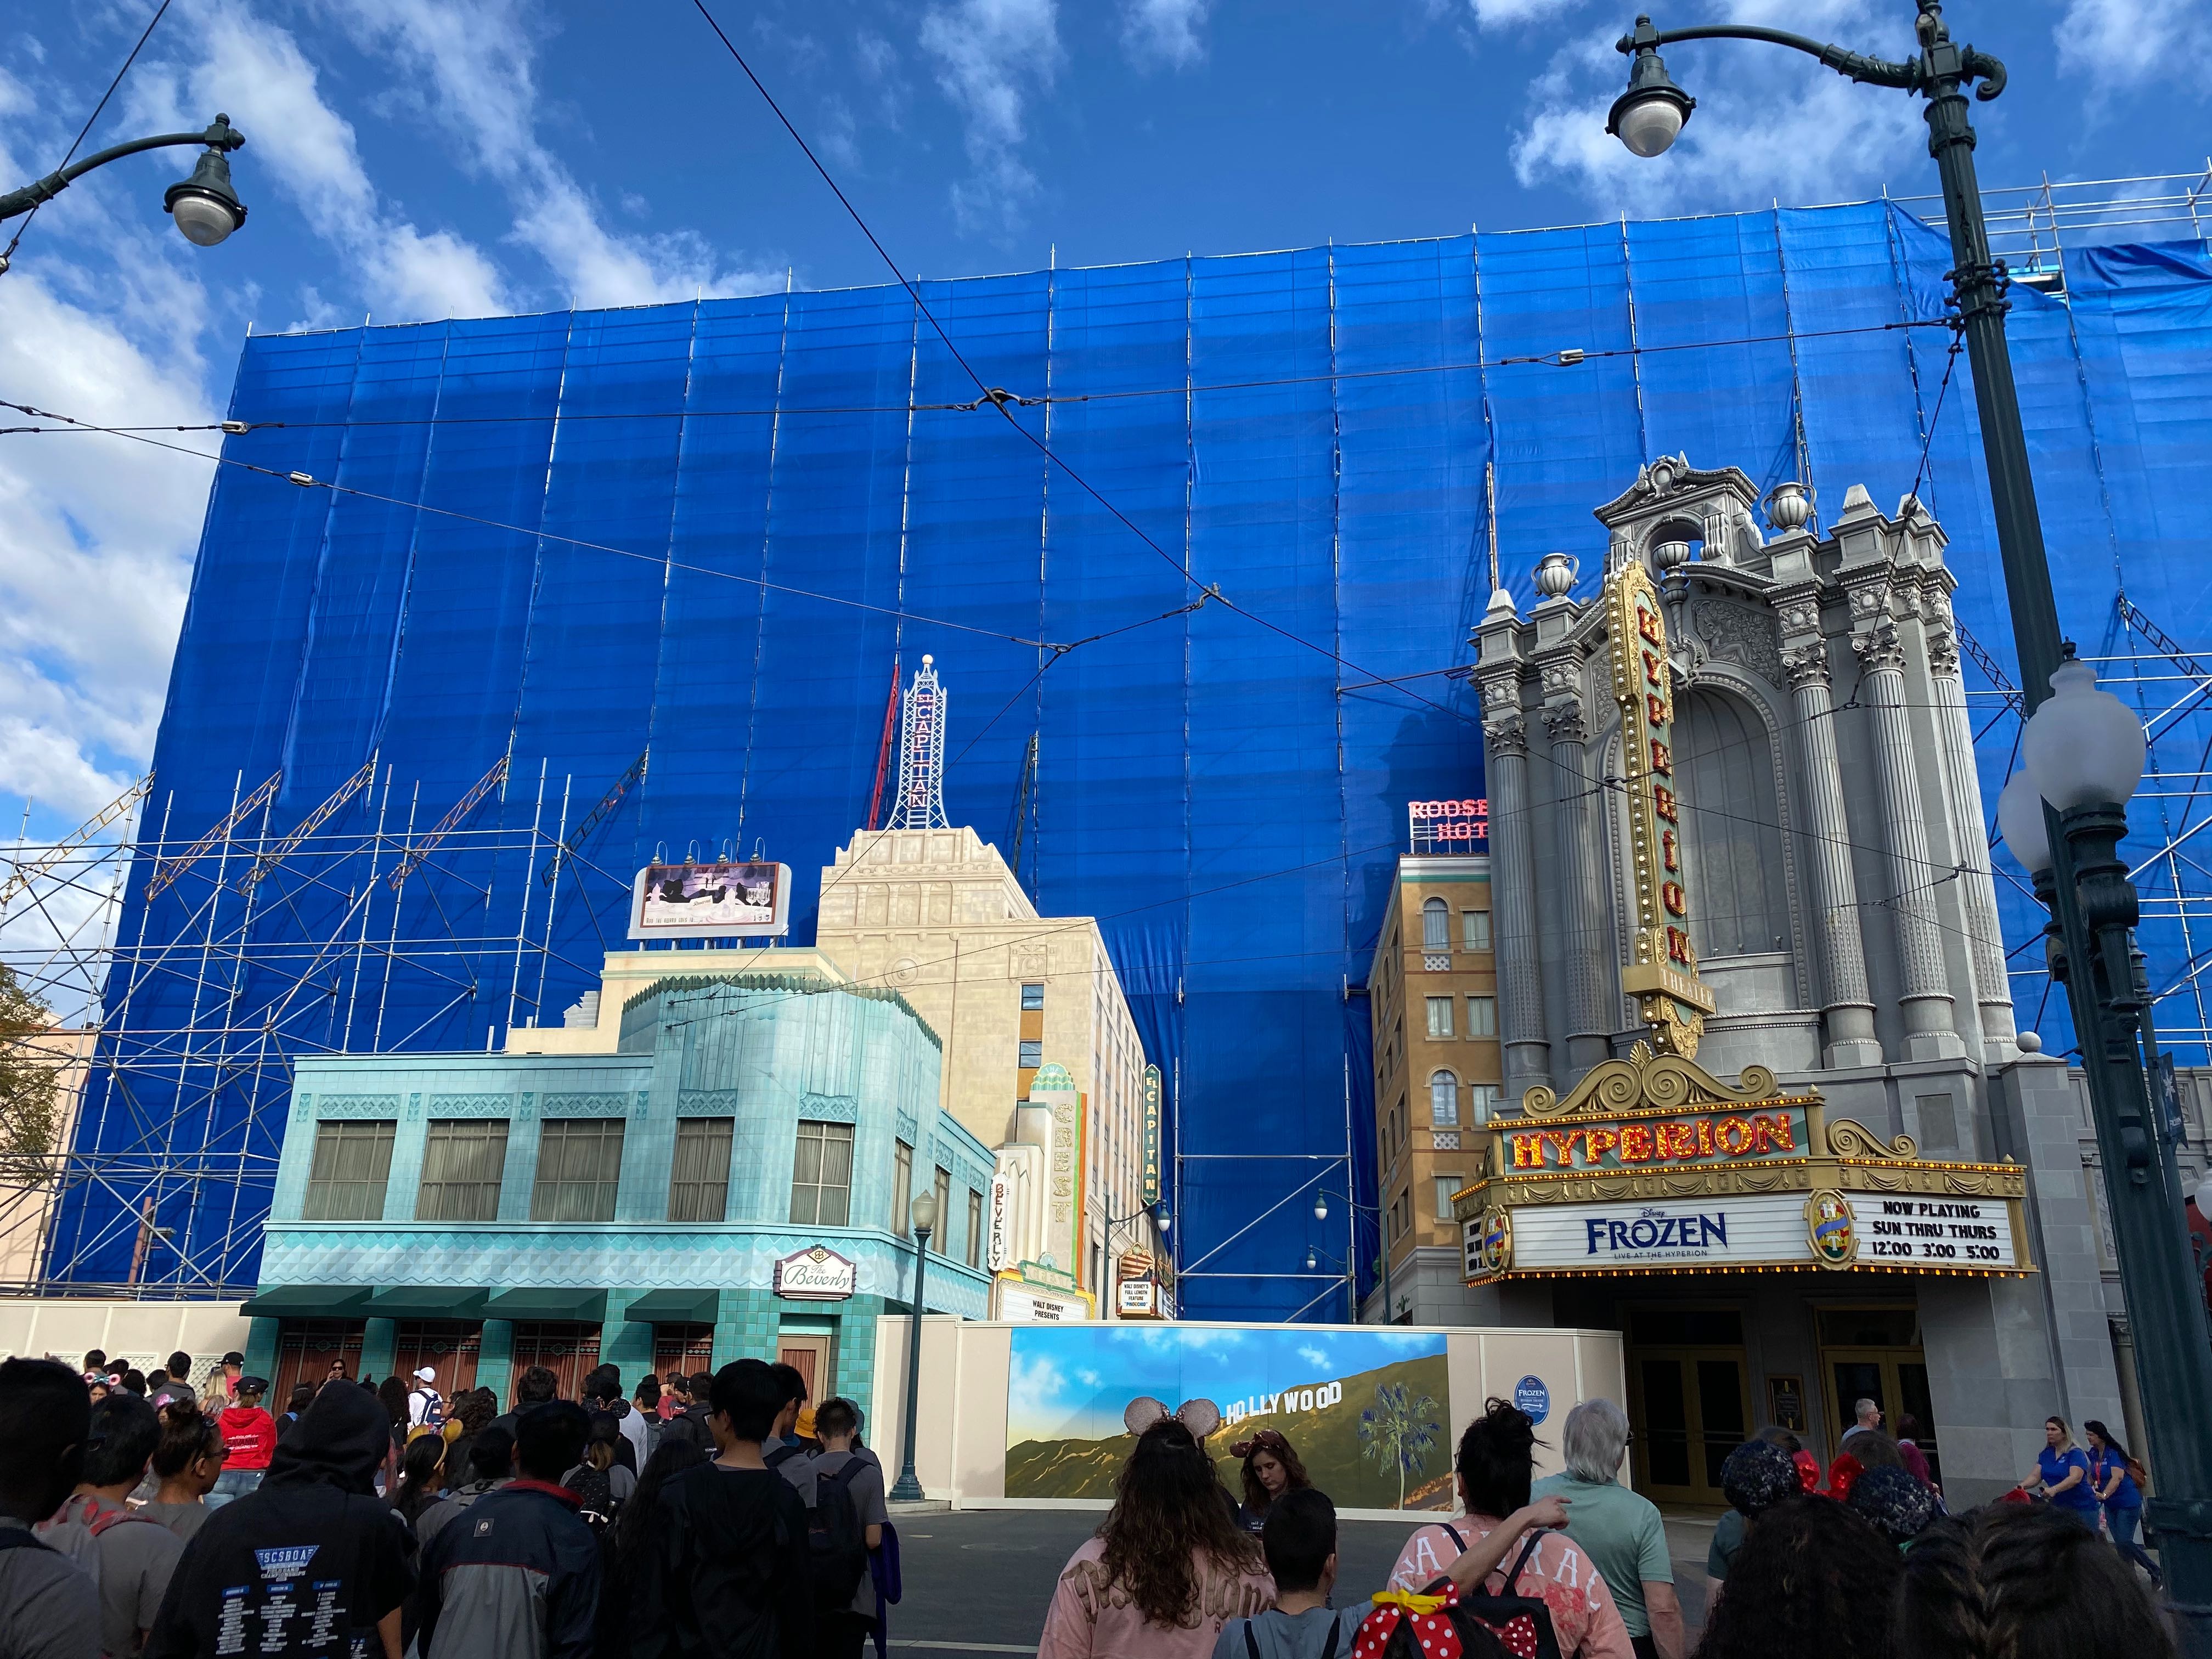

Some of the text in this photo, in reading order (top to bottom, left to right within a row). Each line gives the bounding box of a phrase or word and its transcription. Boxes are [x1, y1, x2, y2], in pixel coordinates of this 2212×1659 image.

[910, 706, 932, 808] CAPITAN
[1638, 605, 1693, 964] HYPERION
[1661, 968, 1714, 1008] THEATER
[1146, 1077, 1158, 1088] EL
[1146, 1091, 1157, 1190] CAPITAN
[1511, 1113, 1796, 1169] HYPERION
[1052, 1104, 1074, 1223] CREST
[1640, 1207, 1665, 1218] Disney
[1883, 1200, 1980, 1218] NOW PLAYING
[992, 1183, 1003, 1267] BEVERLY
[1585, 1212, 1728, 1255] FROZEN
[1873, 1220, 1997, 1239] SUN THRU THURS
[1872, 1240, 2000, 1260] 12:00 3:00 5:00
[784, 1265, 850, 1289] Beverly
[811, 1265, 827, 1274] The
[1029, 1267, 1069, 1288] CREST
[1032, 1300, 1064, 1312] WALT DISNEY
[1035, 1310, 1060, 1321] PRESENTS
[1226, 1381, 1342, 1425] HOLLYWOOD
